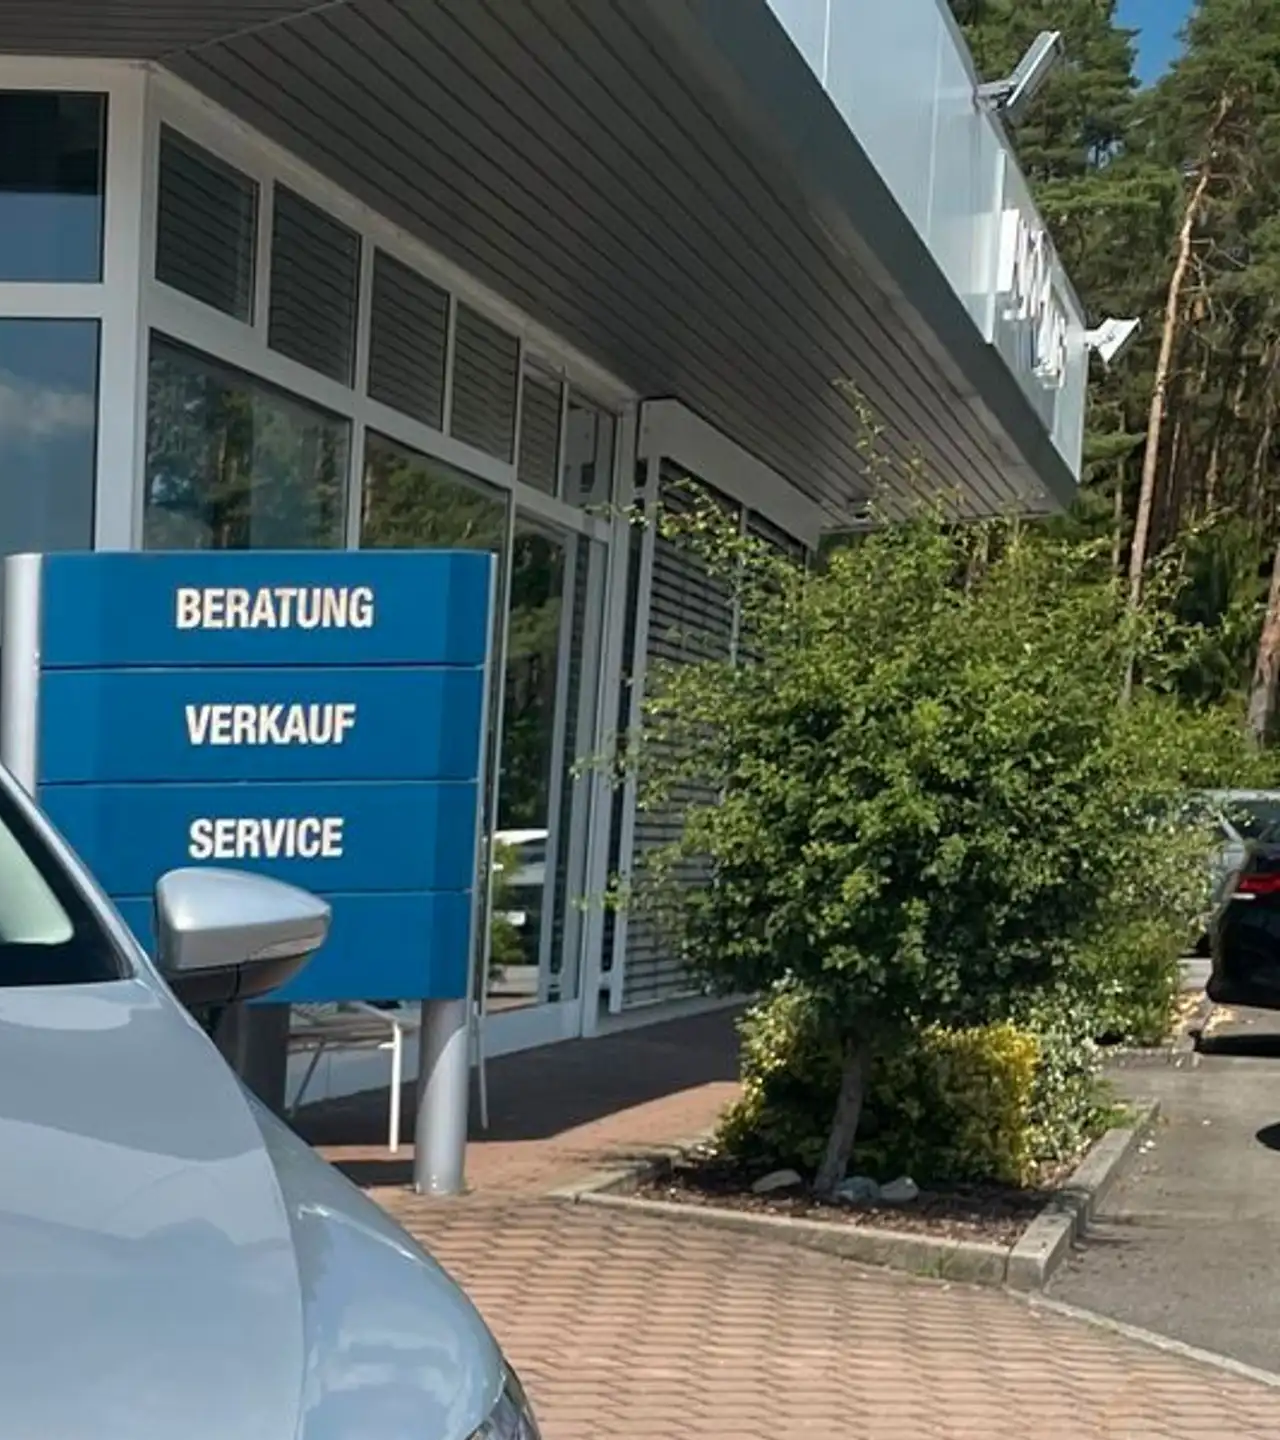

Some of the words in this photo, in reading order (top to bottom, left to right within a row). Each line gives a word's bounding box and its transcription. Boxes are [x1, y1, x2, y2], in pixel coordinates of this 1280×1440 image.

[175, 586, 375, 629] BERATUNG
[184, 703, 357, 746] VERKAUF
[188, 817, 345, 860] SERVICE
